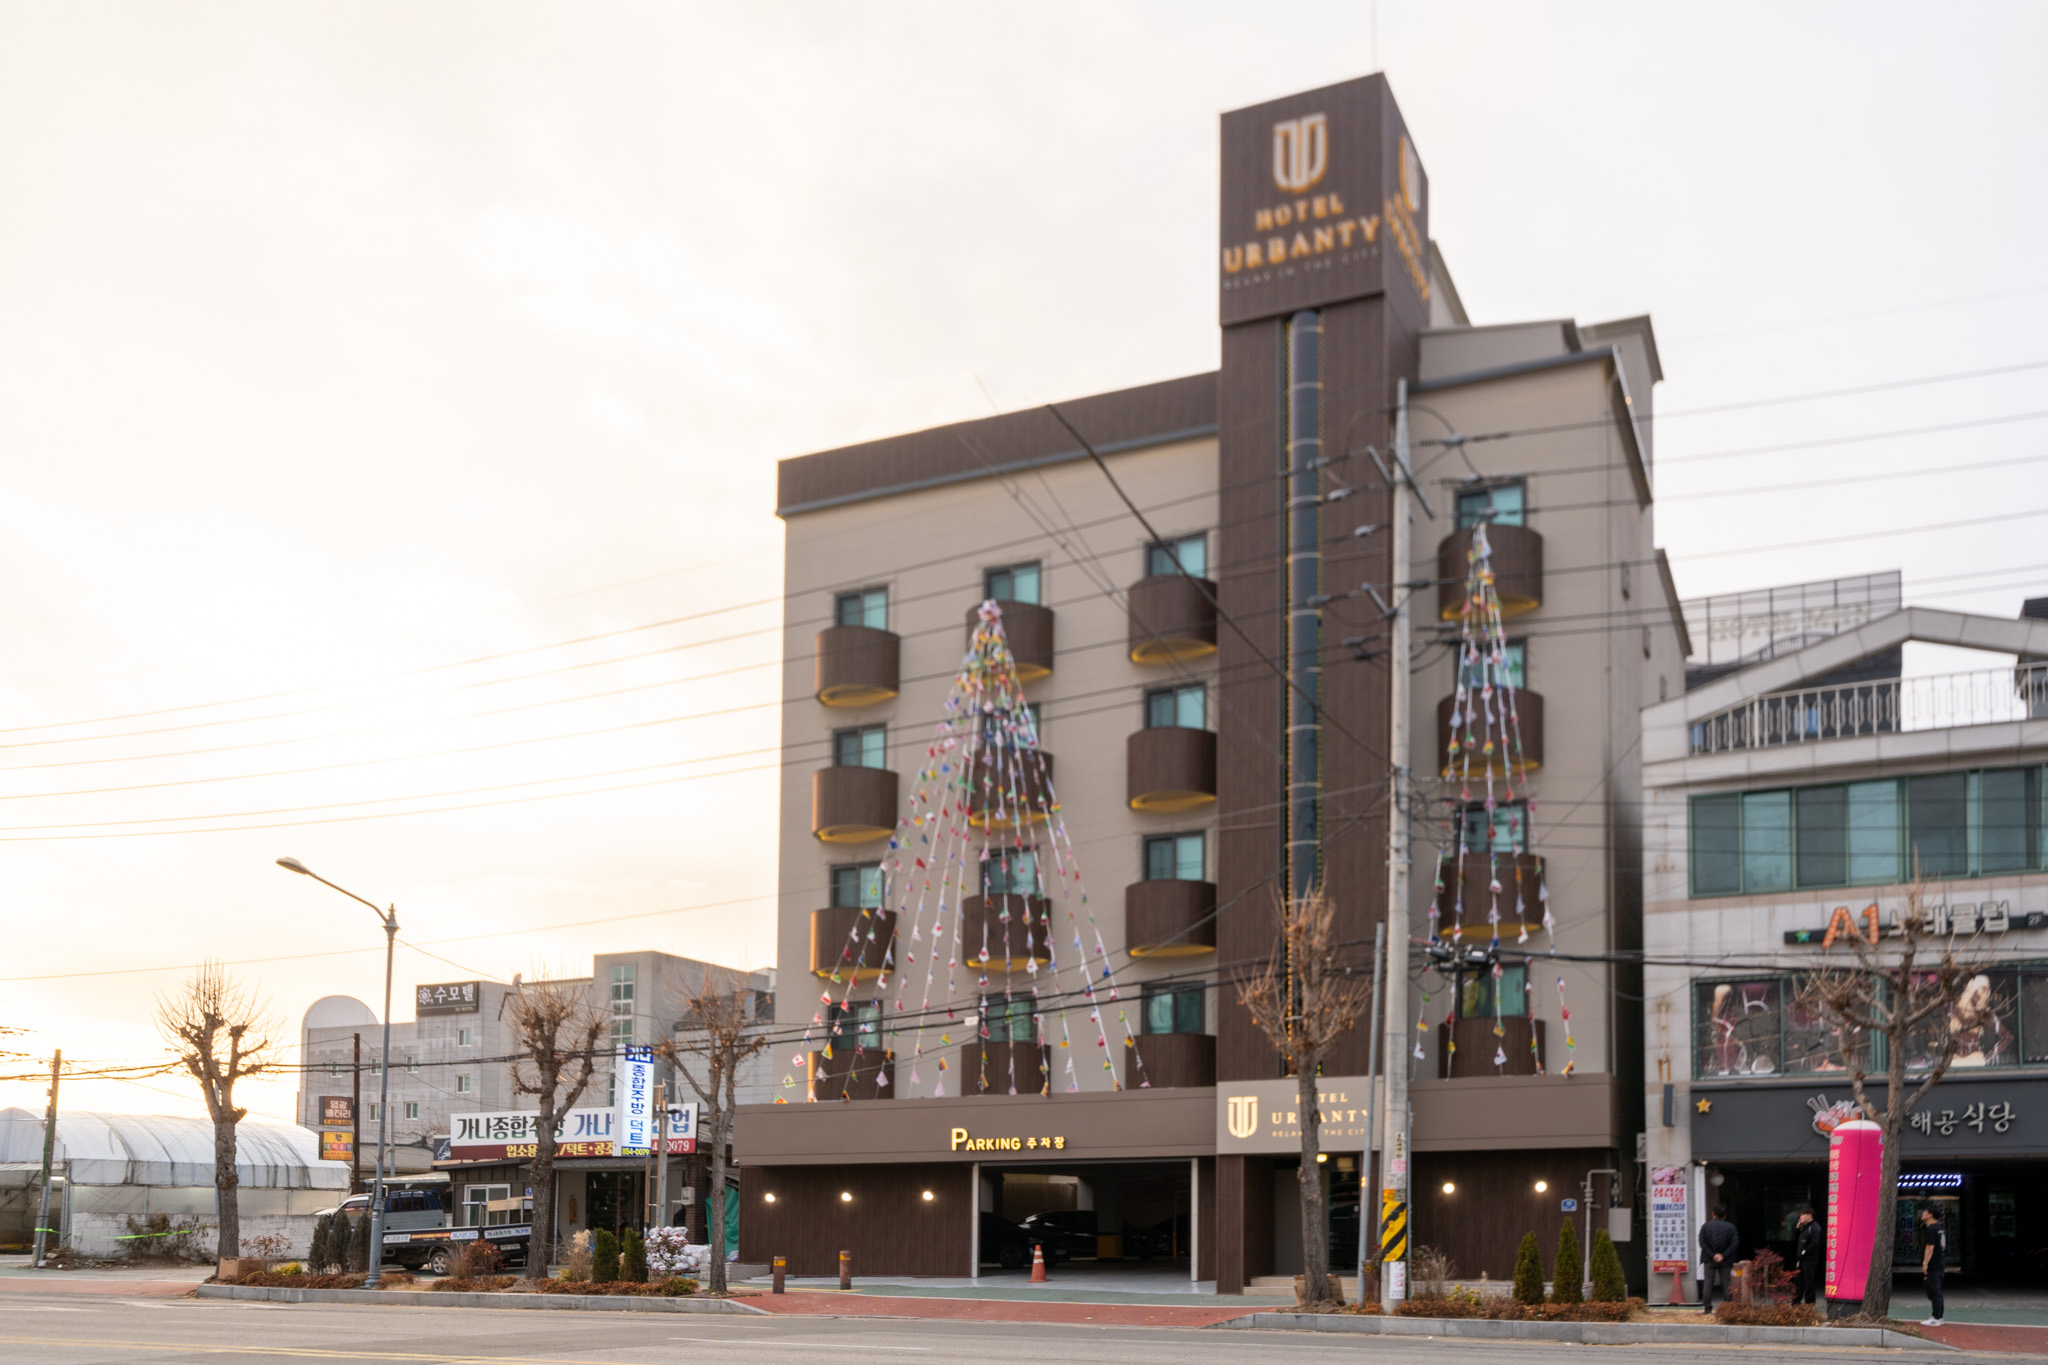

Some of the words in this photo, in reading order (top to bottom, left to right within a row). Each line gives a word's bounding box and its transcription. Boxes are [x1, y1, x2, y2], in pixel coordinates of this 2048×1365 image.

[1254, 192, 1344, 232] HOTEL
[1222, 213, 1380, 274] URBANTY
[1822, 903, 1879, 949] A1
[2027, 913, 2043, 927] 2F
[433, 983, 474, 1004] 수모텔
[1295, 1092, 1348, 1105] HTEL
[1271, 1109, 1368, 1125] URANTY
[1905, 1100, 2017, 1137] 해공식당
[951, 1127, 1021, 1151] PARKING
[1026, 1136, 1066, 1150] 주차장
[1324, 1128, 1342, 1136] THE
